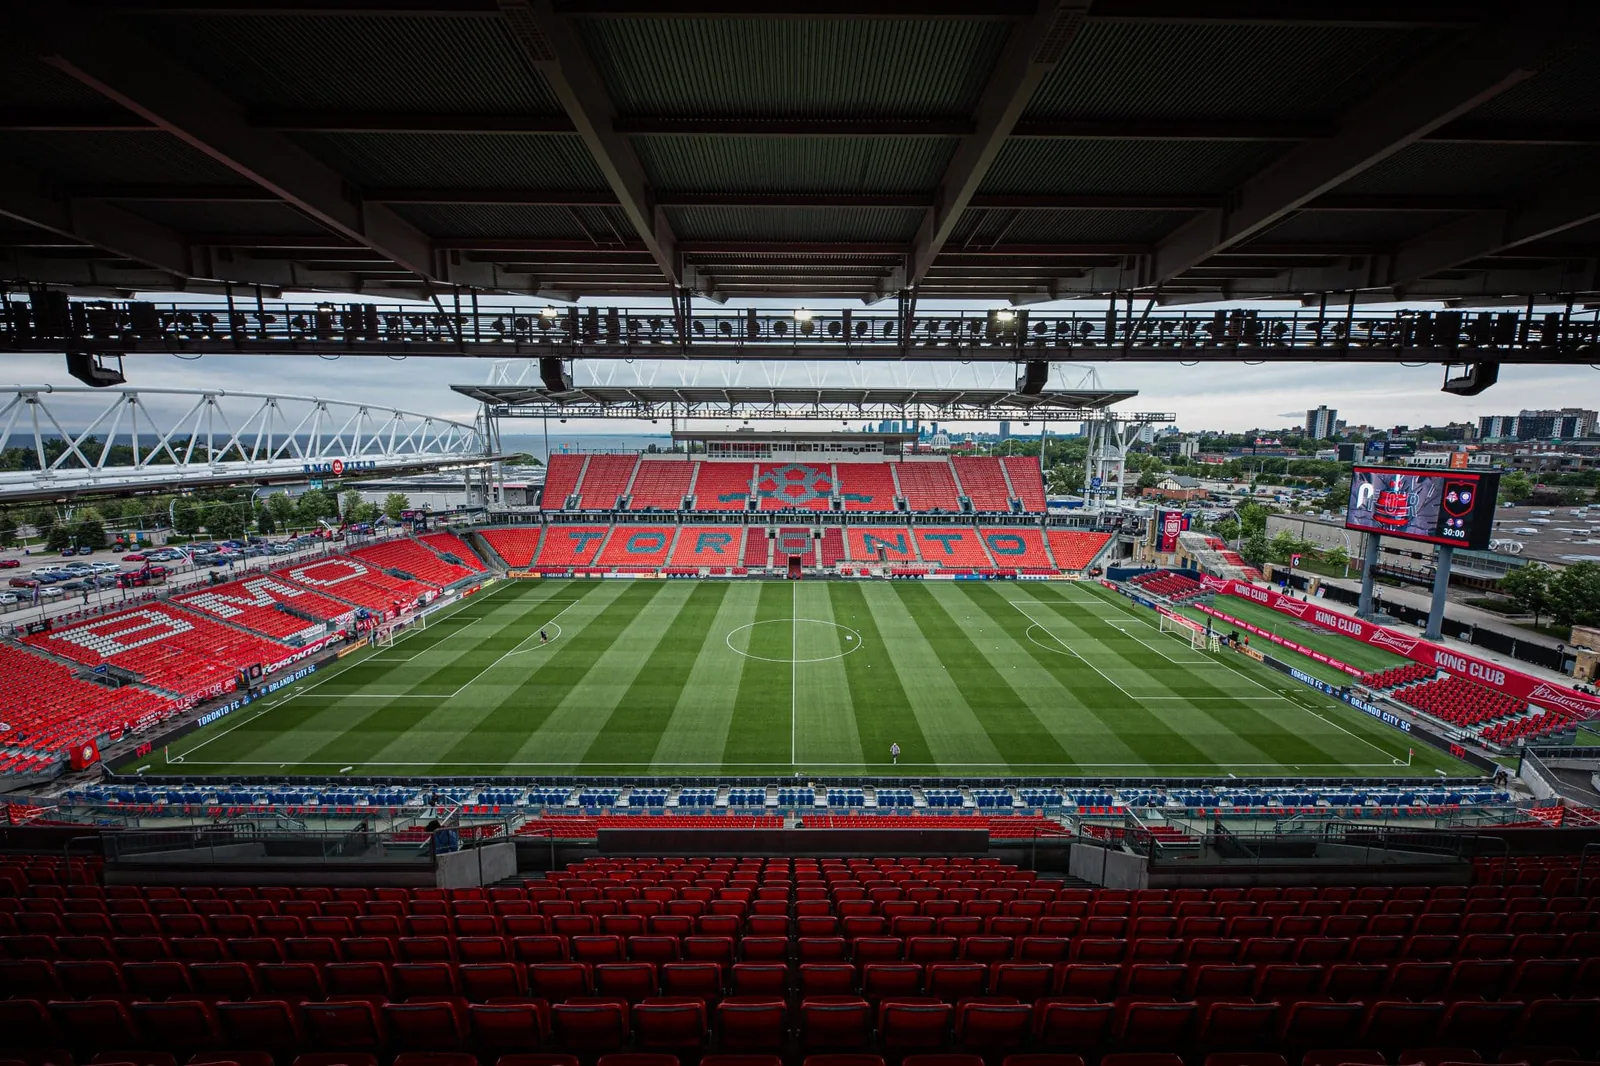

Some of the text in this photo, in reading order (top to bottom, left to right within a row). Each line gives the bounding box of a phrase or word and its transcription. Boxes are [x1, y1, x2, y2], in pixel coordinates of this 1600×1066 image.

[303, 461, 376, 473] BMO FIELD
[568, 532, 1027, 555] TORONTO
[1443, 528, 1465, 538] 30:00
[1293, 557, 1299, 566] 6
[1235, 583, 1268, 602] KING CLUB
[1315, 610, 1362, 636] KING CLUB
[1373, 630, 1413, 651] Budweiser
[268, 664, 316, 692] ORLANDO CITY SC
[1290, 668, 1323, 690] TORONTO FC
[1435, 650, 1505, 686] KING CLUB
[1534, 685, 1597, 713] Budweiser
[197, 700, 240, 726] TORONTO FC
[1350, 697, 1411, 732] ORLANDO CITY SC
